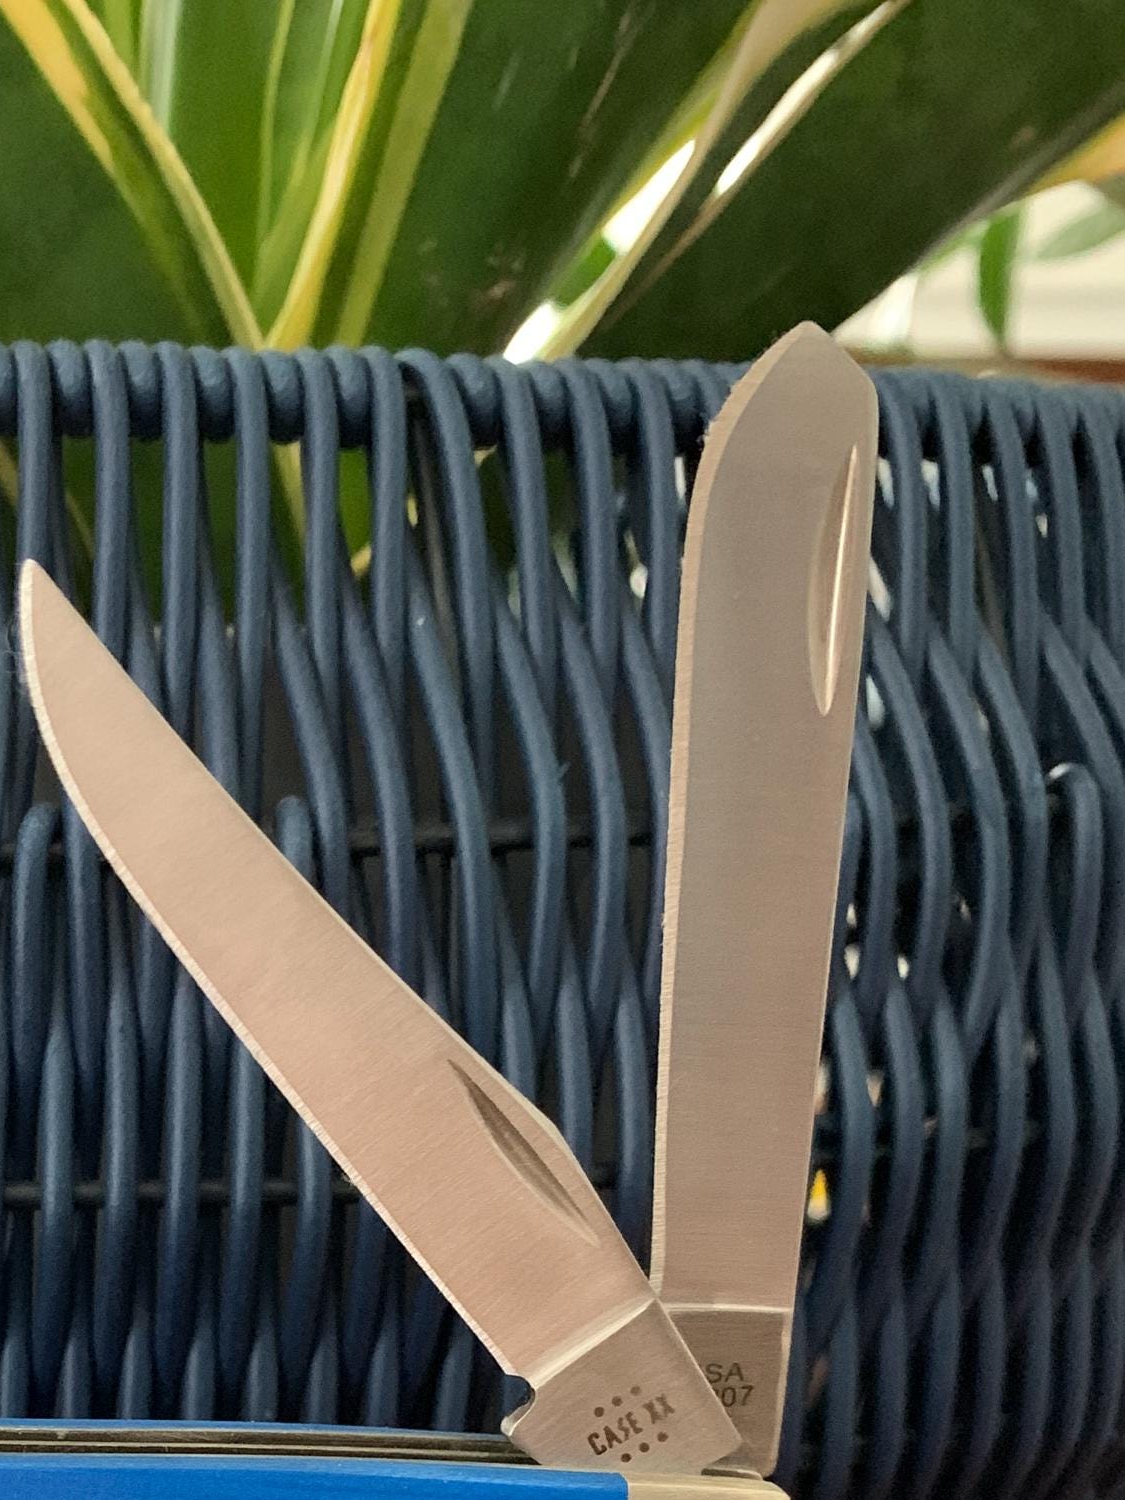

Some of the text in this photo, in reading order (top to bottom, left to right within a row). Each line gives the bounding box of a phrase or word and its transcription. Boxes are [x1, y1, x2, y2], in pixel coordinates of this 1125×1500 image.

[705, 1362, 744, 1384] SA
[713, 1384, 754, 1408] 07
[587, 1393, 675, 1456] CASE XX
